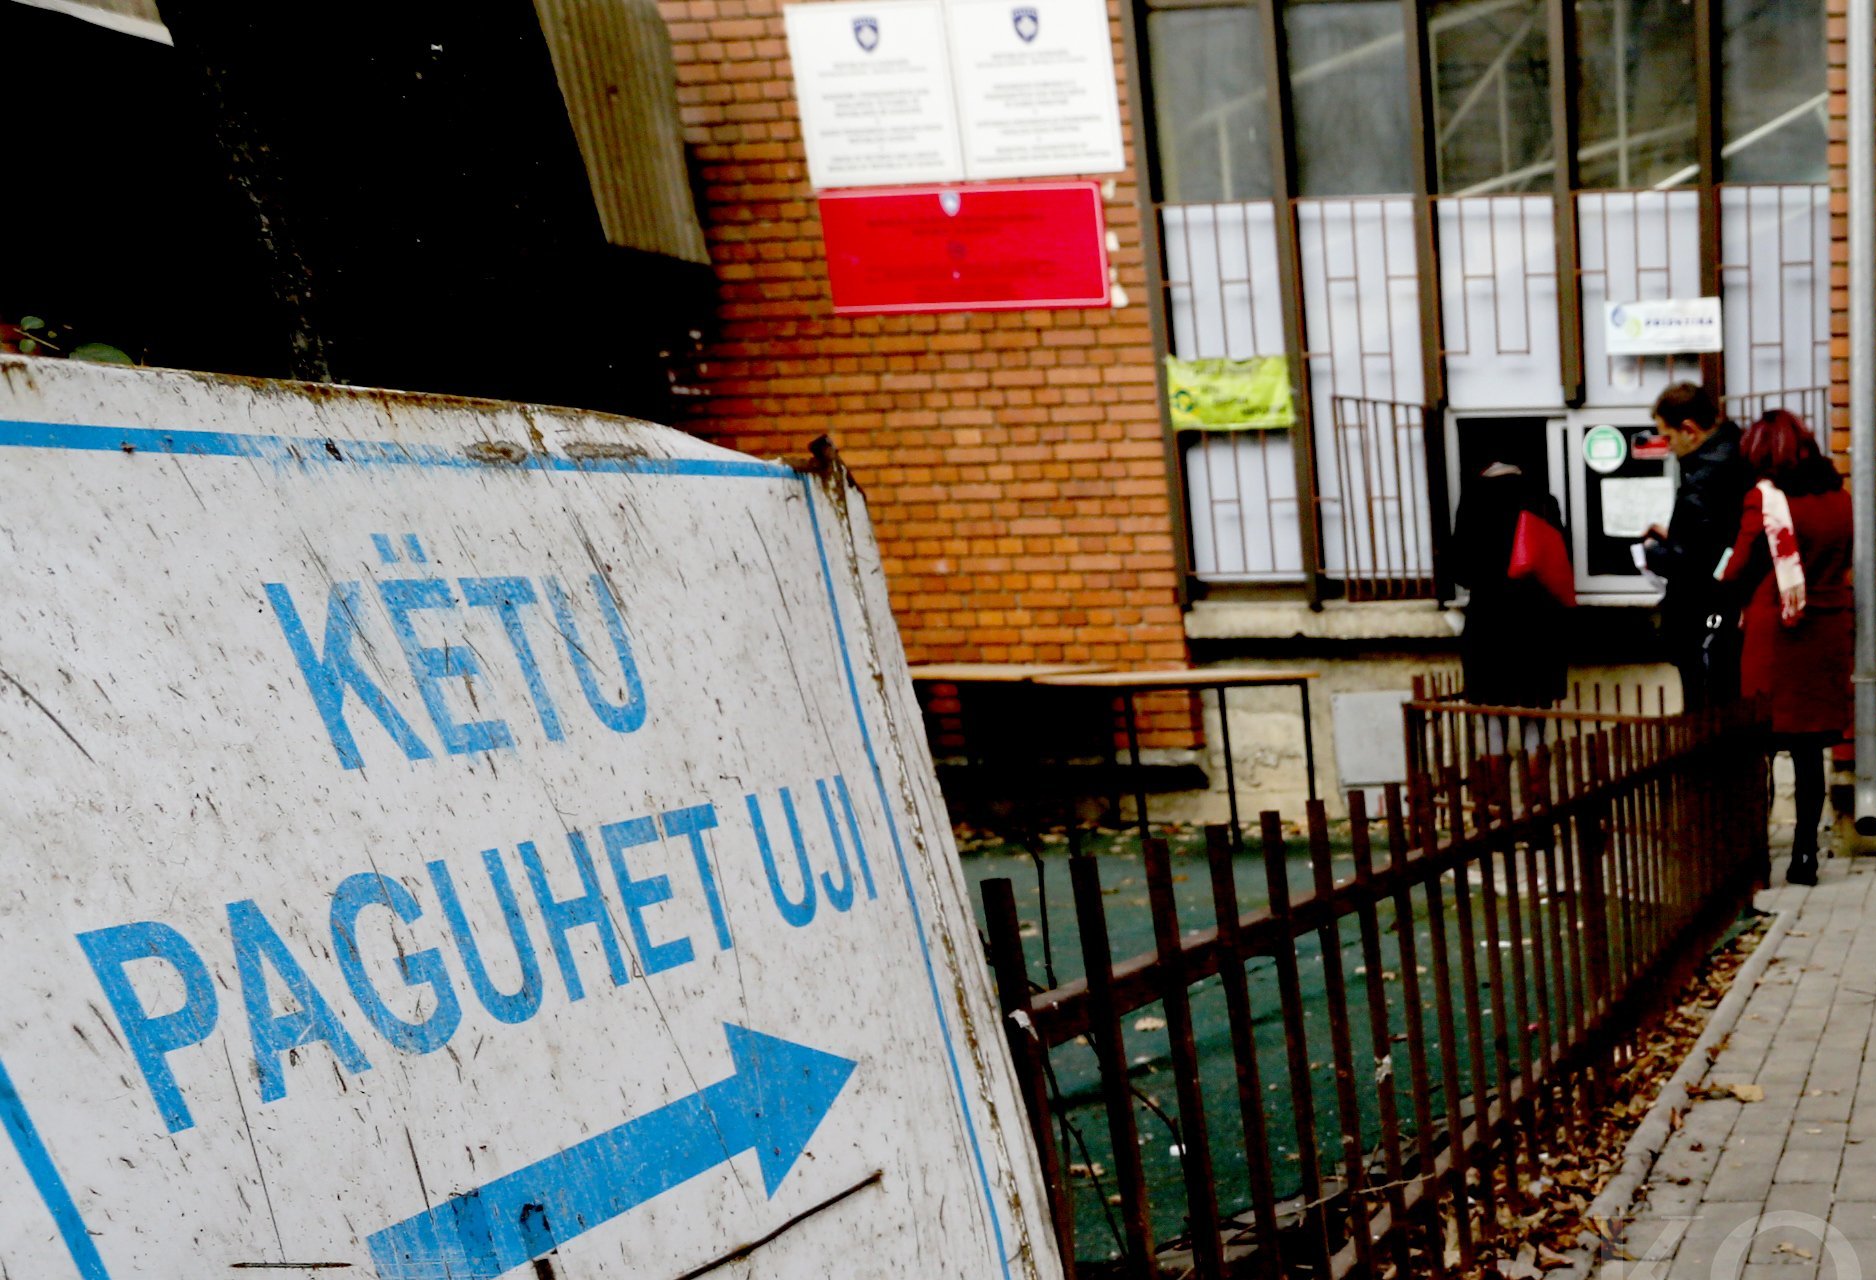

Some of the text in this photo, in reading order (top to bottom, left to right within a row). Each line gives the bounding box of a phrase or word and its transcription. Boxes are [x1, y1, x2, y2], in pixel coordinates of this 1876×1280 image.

[263, 533, 647, 770] KËTU
[75, 774, 879, 1133] PAGUHET UJI
